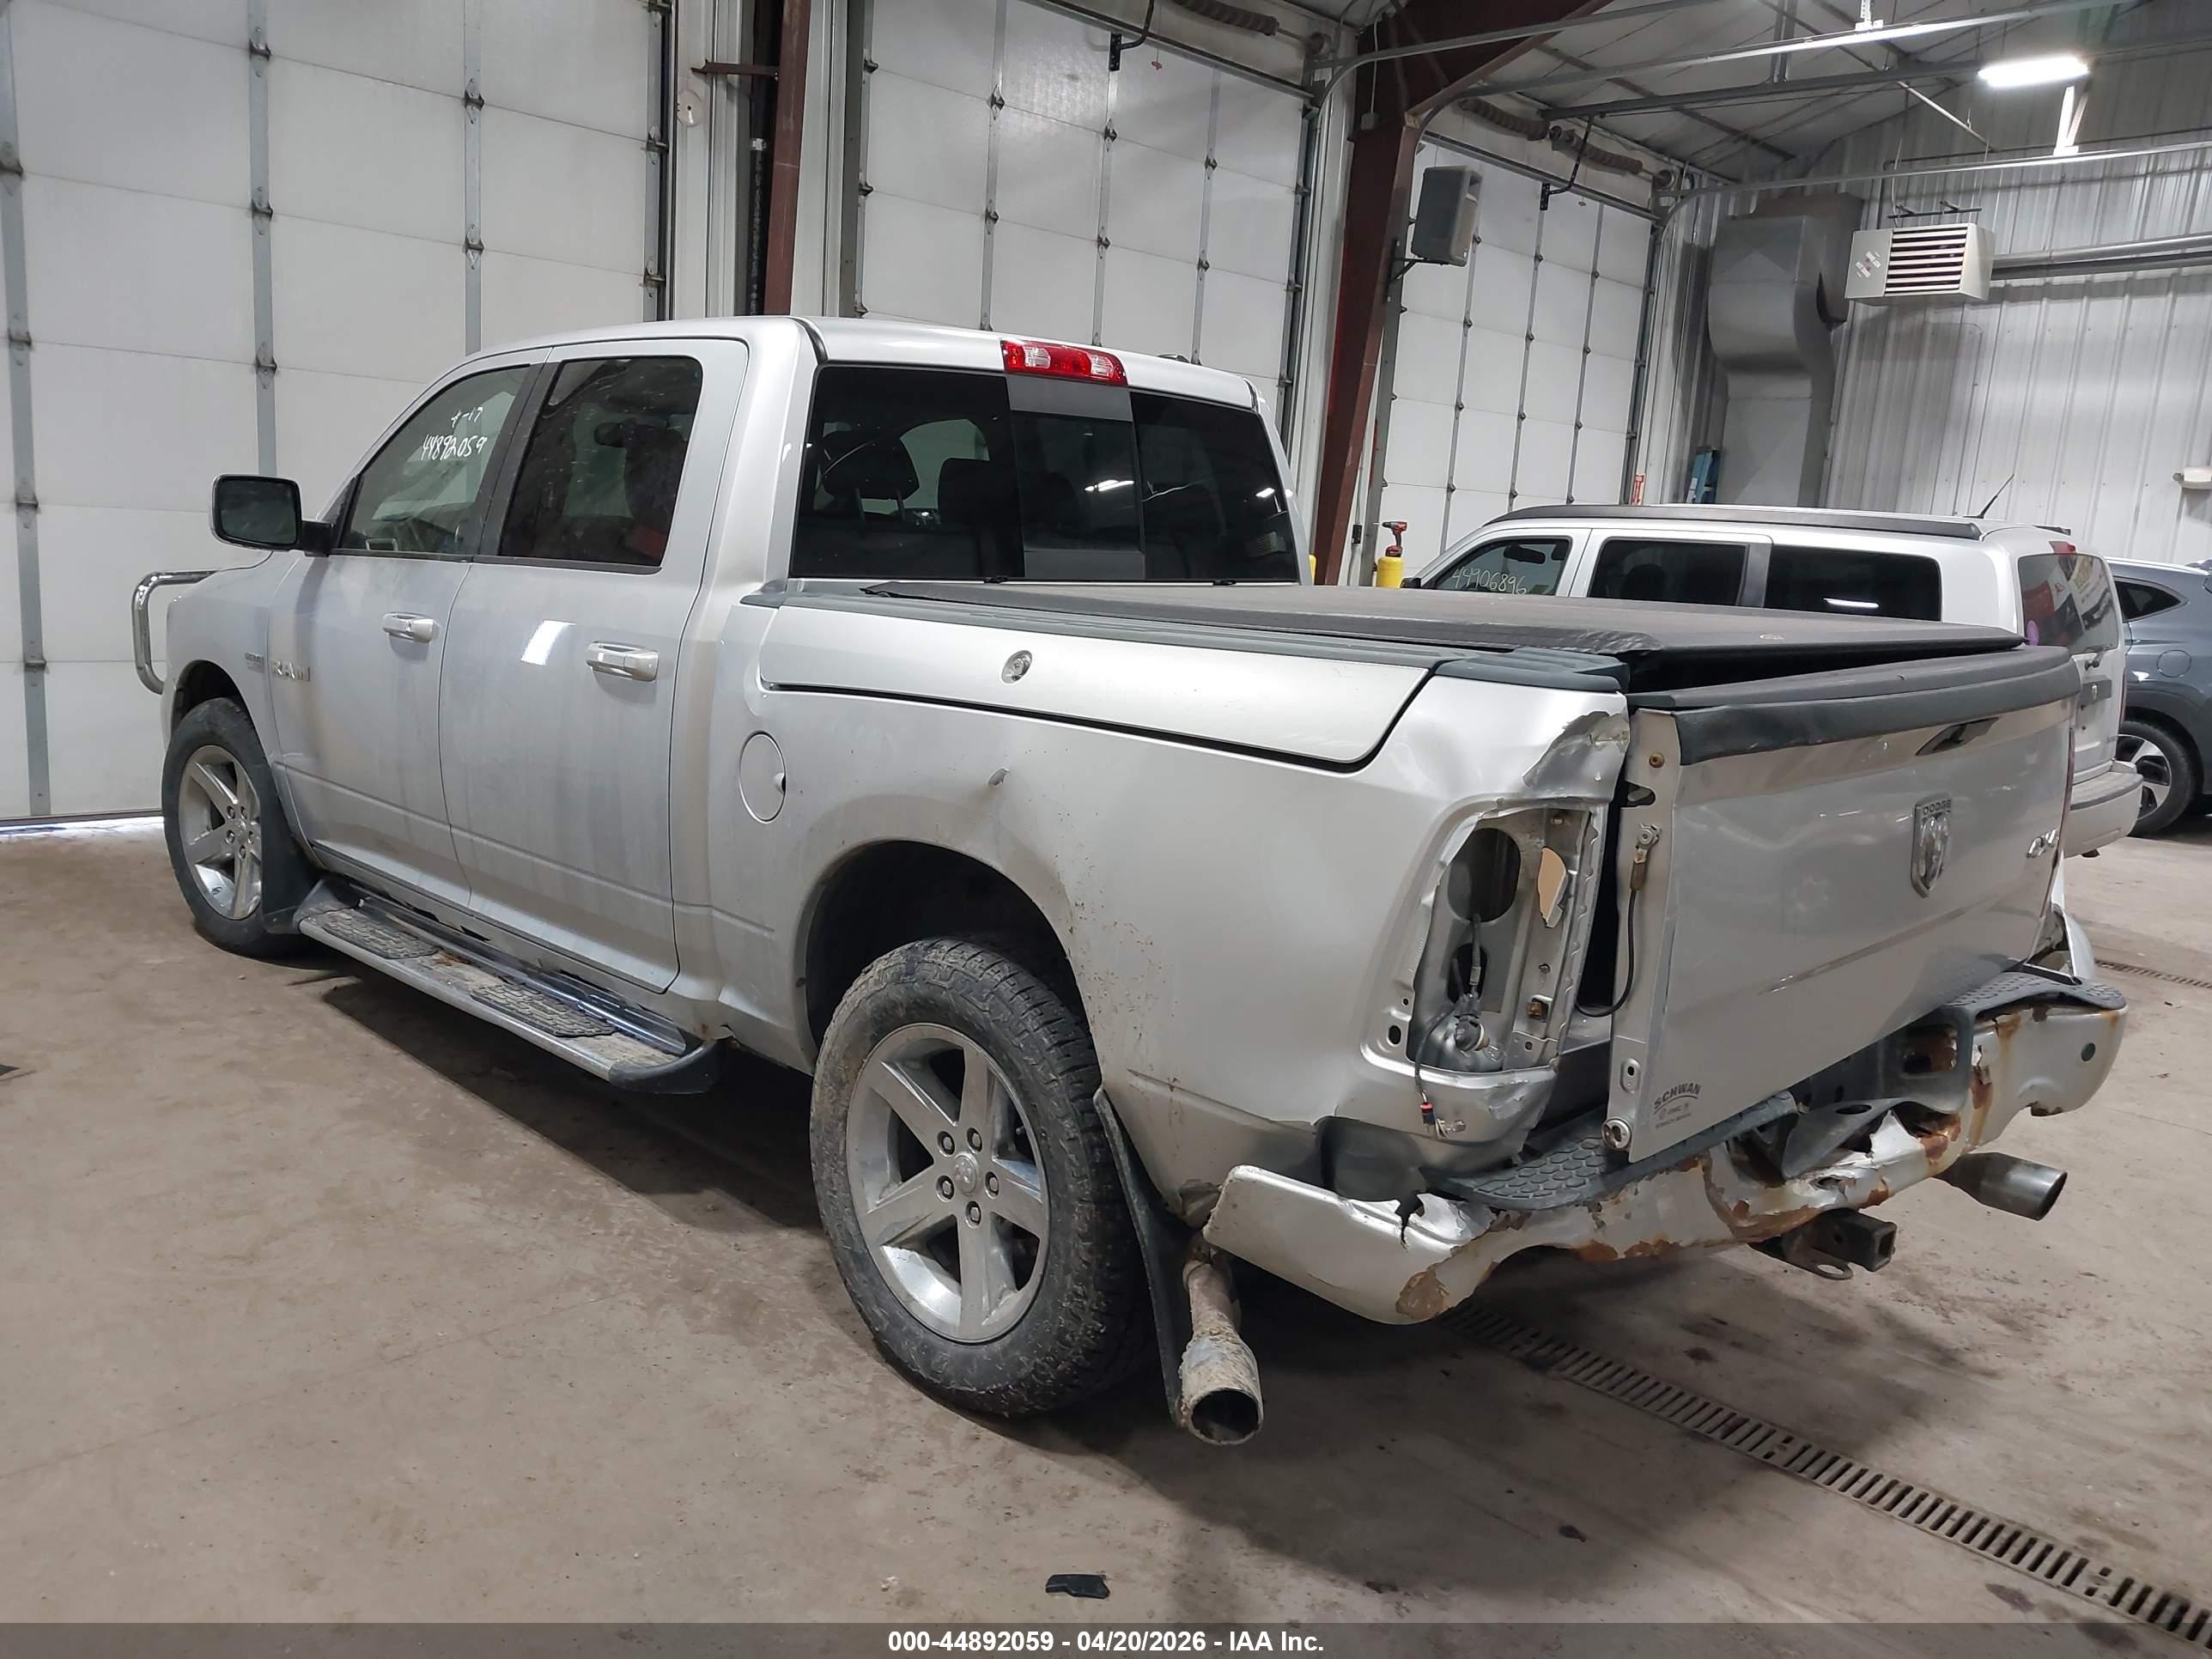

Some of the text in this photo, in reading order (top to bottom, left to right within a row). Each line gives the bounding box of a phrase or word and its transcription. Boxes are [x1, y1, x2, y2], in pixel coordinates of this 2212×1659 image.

[420, 433, 488, 461] 44892059
[271, 659, 311, 683] RAM
[1923, 799, 1952, 815] DODGE
[1654, 1083, 1702, 1110] SCHWAN
